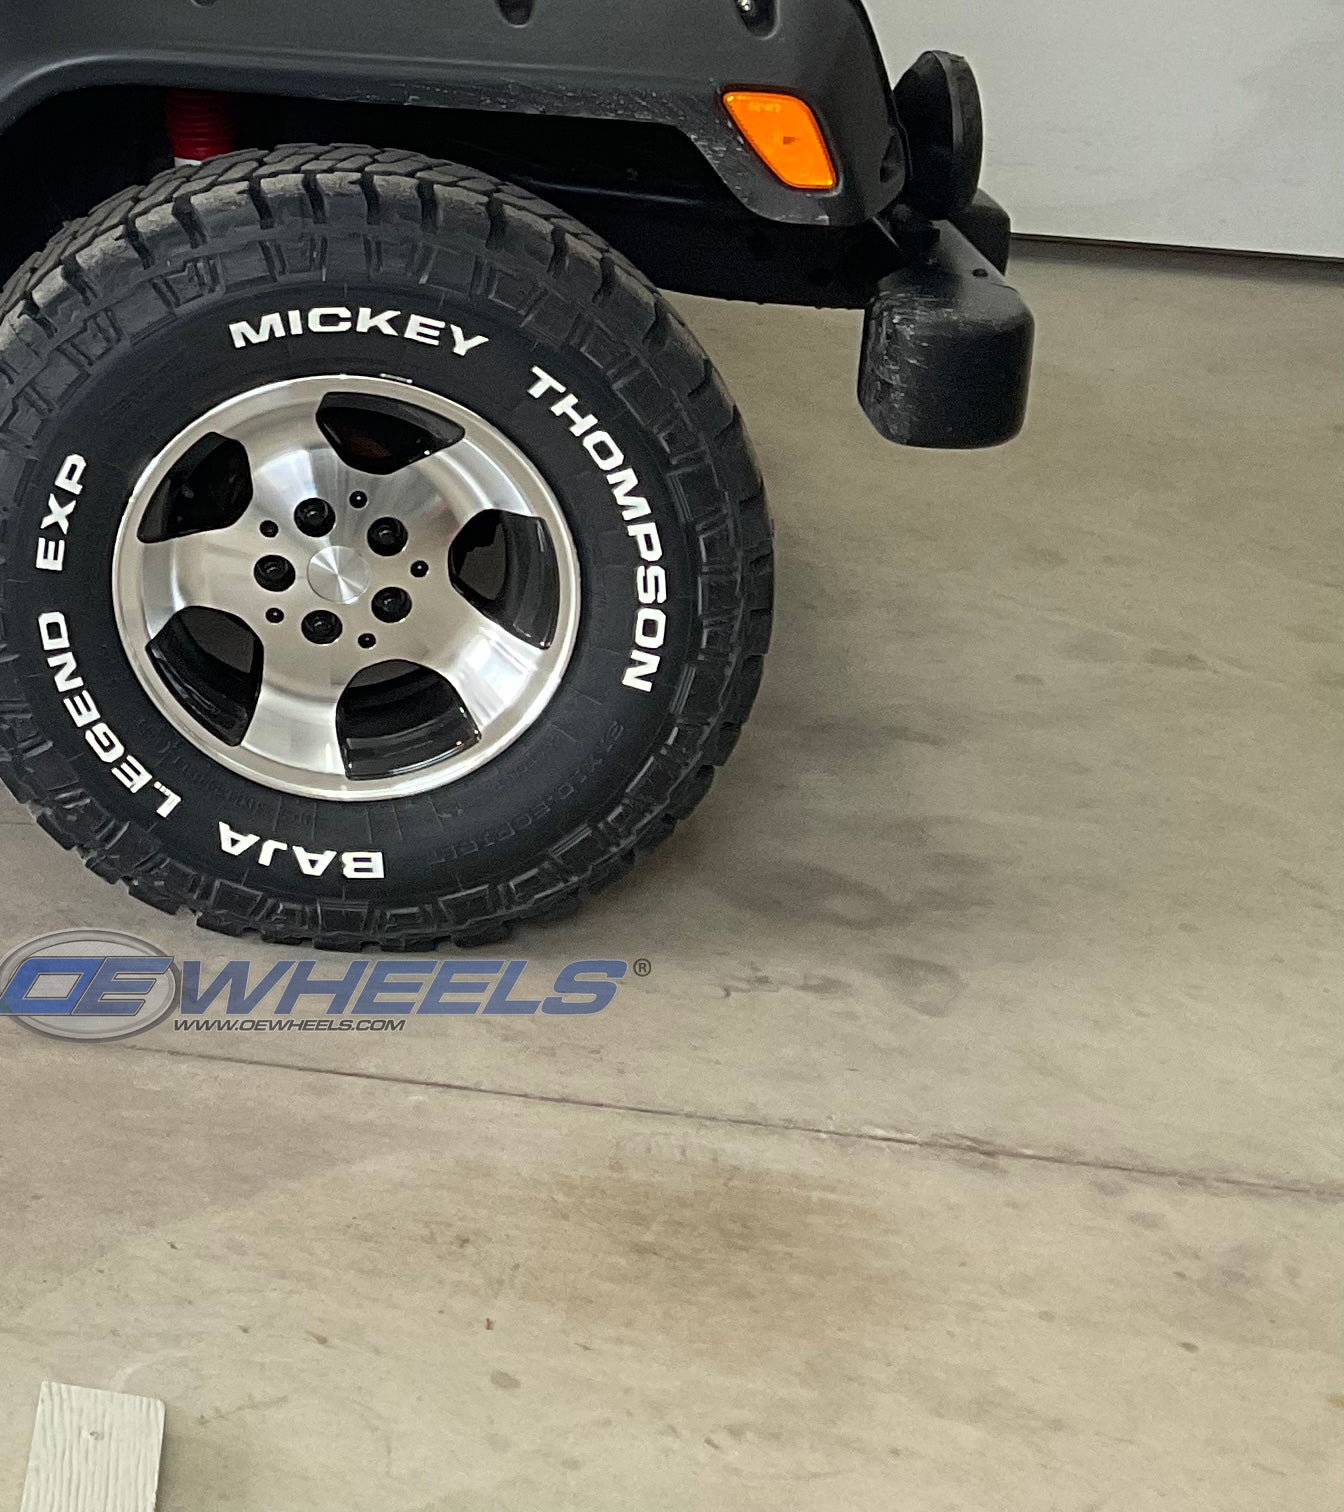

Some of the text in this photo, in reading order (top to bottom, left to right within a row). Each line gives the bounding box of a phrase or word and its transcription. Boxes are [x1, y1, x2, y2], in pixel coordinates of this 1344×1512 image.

[35, 453, 87, 572] EXP
[228, 306, 667, 694] MICKEY THOMPSON
[37, 612, 182, 819] LEGEND
[218, 821, 385, 879] BAJA
